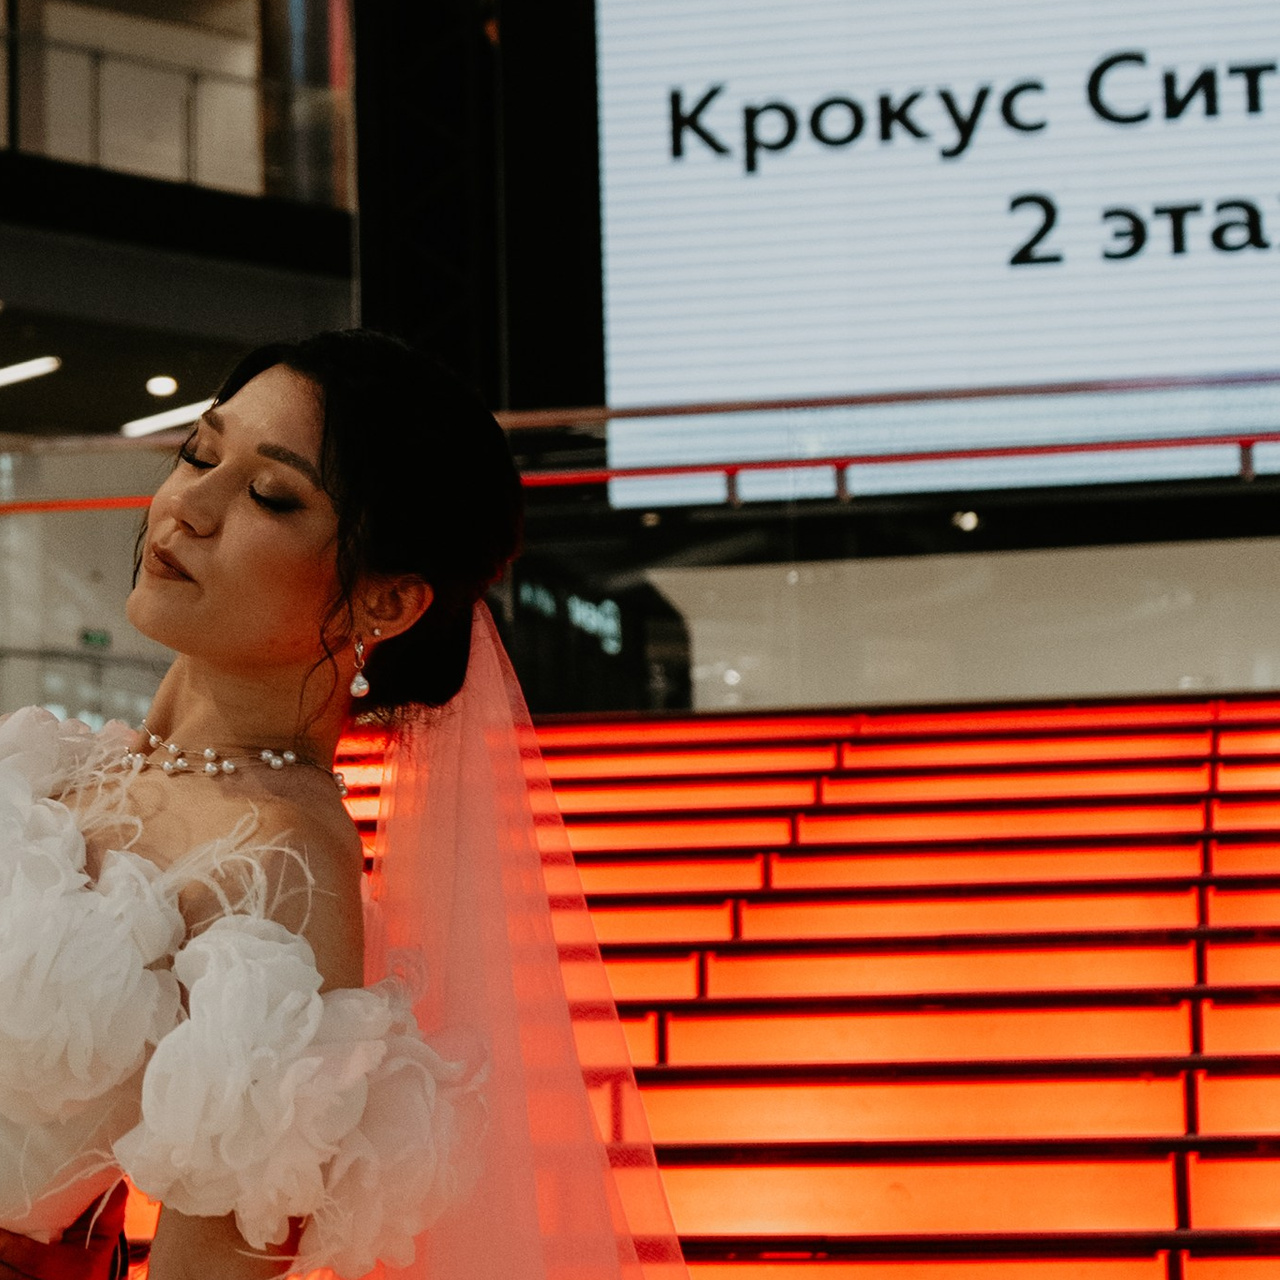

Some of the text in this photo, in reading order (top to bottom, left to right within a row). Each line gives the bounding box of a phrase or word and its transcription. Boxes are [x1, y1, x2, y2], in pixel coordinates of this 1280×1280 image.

[670, 52, 1278, 173] Крокус Сит
[1010, 194, 1270, 265] 2 эта
